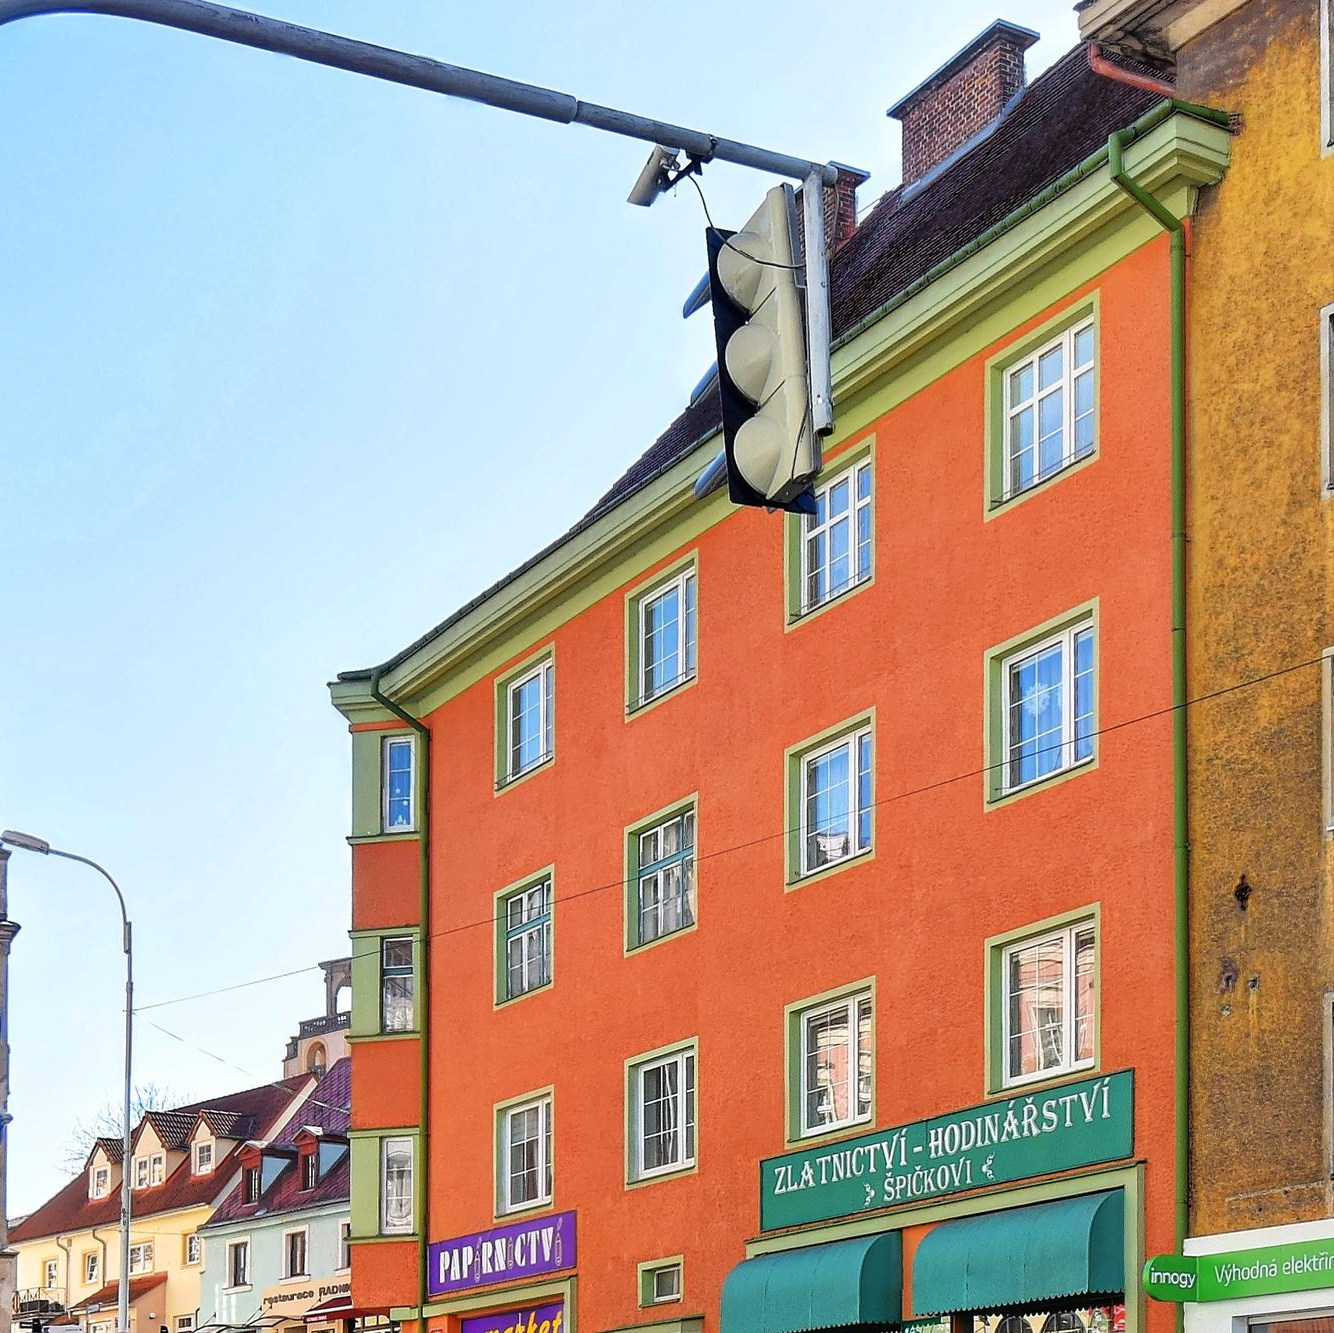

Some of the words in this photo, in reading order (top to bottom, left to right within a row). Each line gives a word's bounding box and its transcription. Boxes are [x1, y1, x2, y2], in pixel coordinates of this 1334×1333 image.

[773, 1127, 908, 1195] ZLATNICTVÍ
[929, 1077, 1111, 1159] HODINÁŘSTVÍ
[883, 1158, 973, 1200] ŠPIČKOVI
[1150, 1267, 1196, 1288] innogy
[1214, 1258, 1278, 1287] Výhodná
